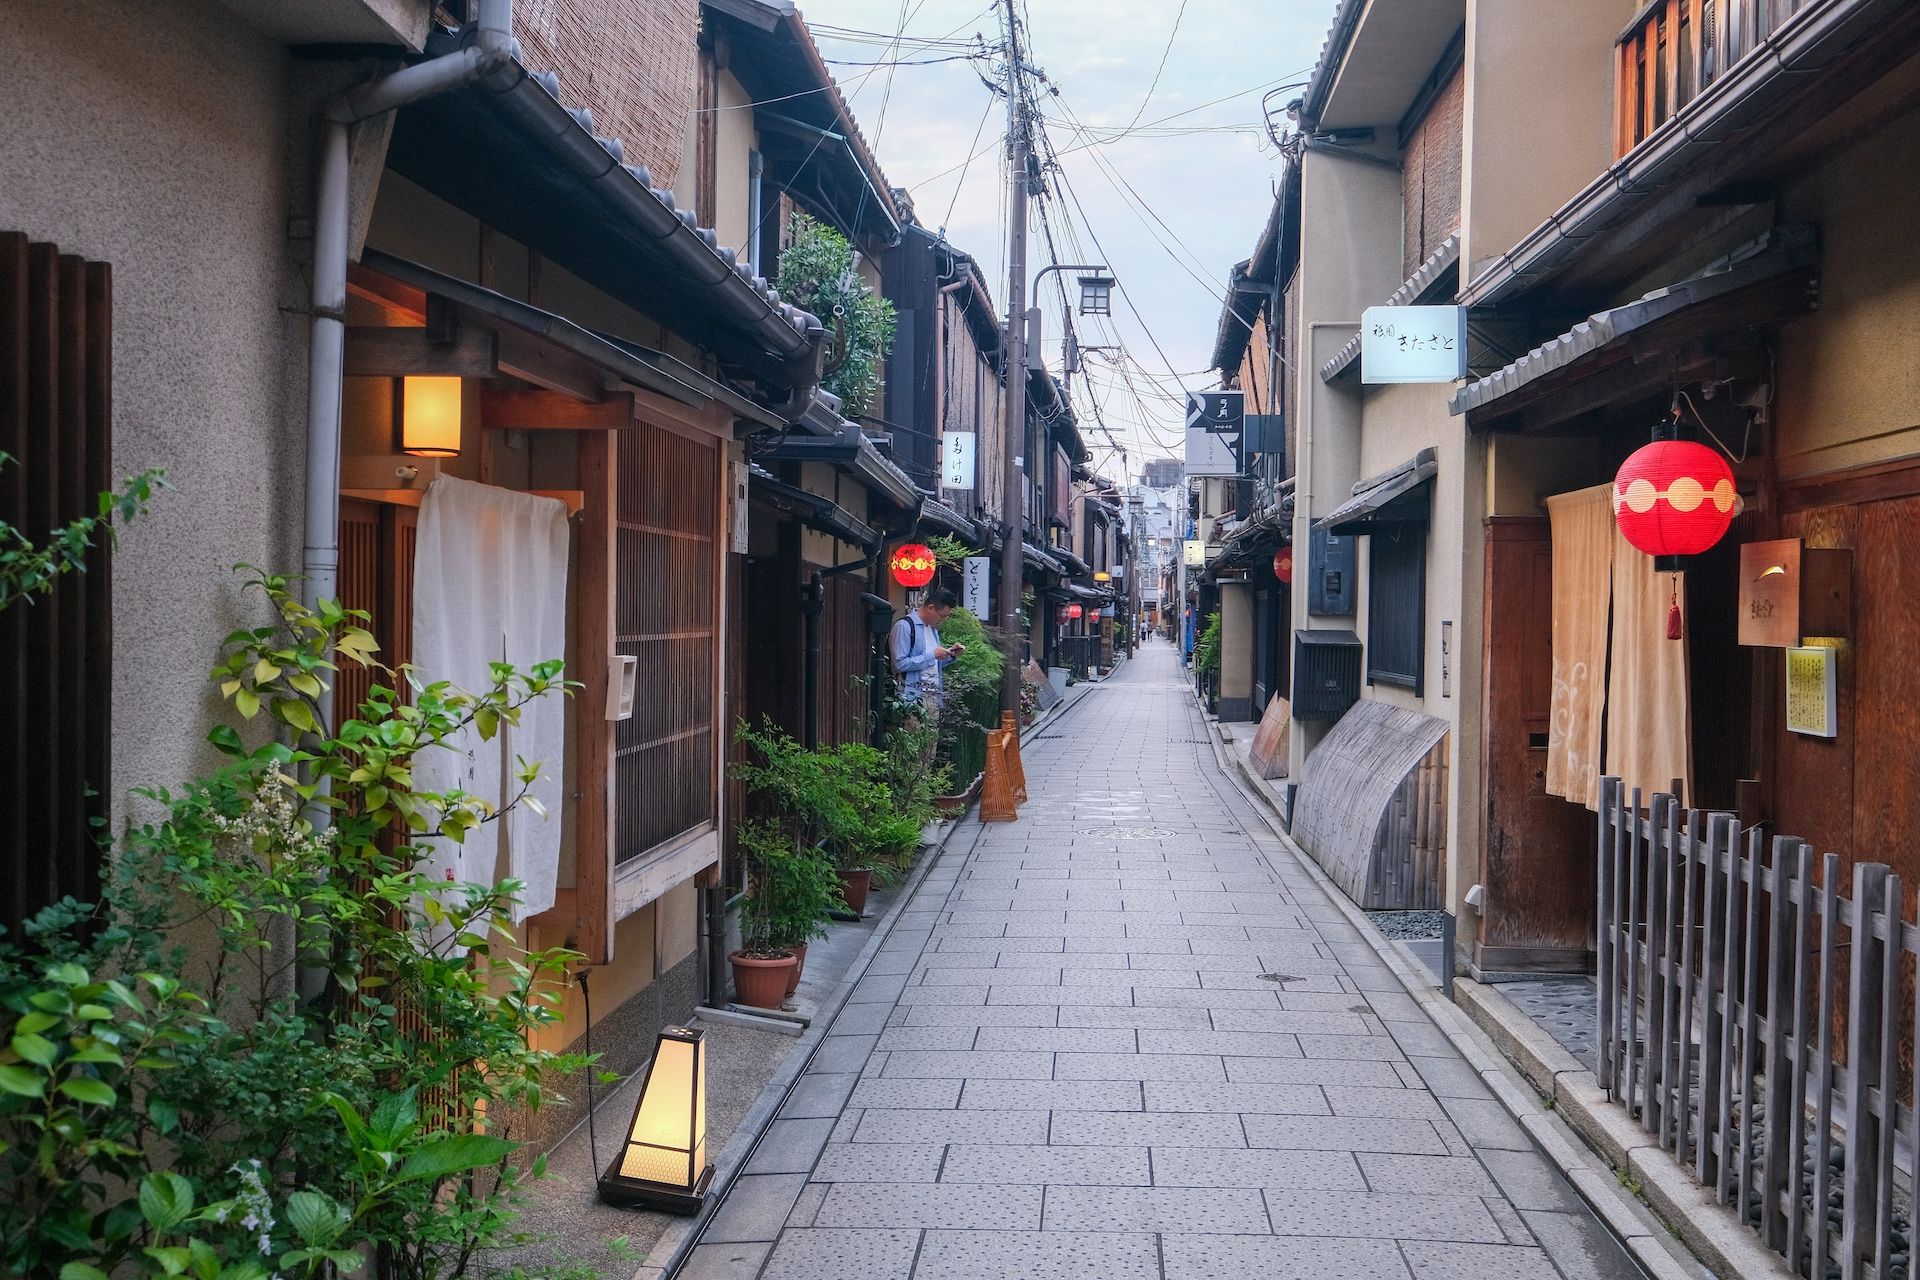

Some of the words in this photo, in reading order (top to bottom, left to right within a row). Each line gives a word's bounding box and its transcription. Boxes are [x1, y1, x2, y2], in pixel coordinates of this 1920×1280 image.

[1397, 333, 1454, 352] きたざと
[969, 560, 981, 617] どうどすえ
